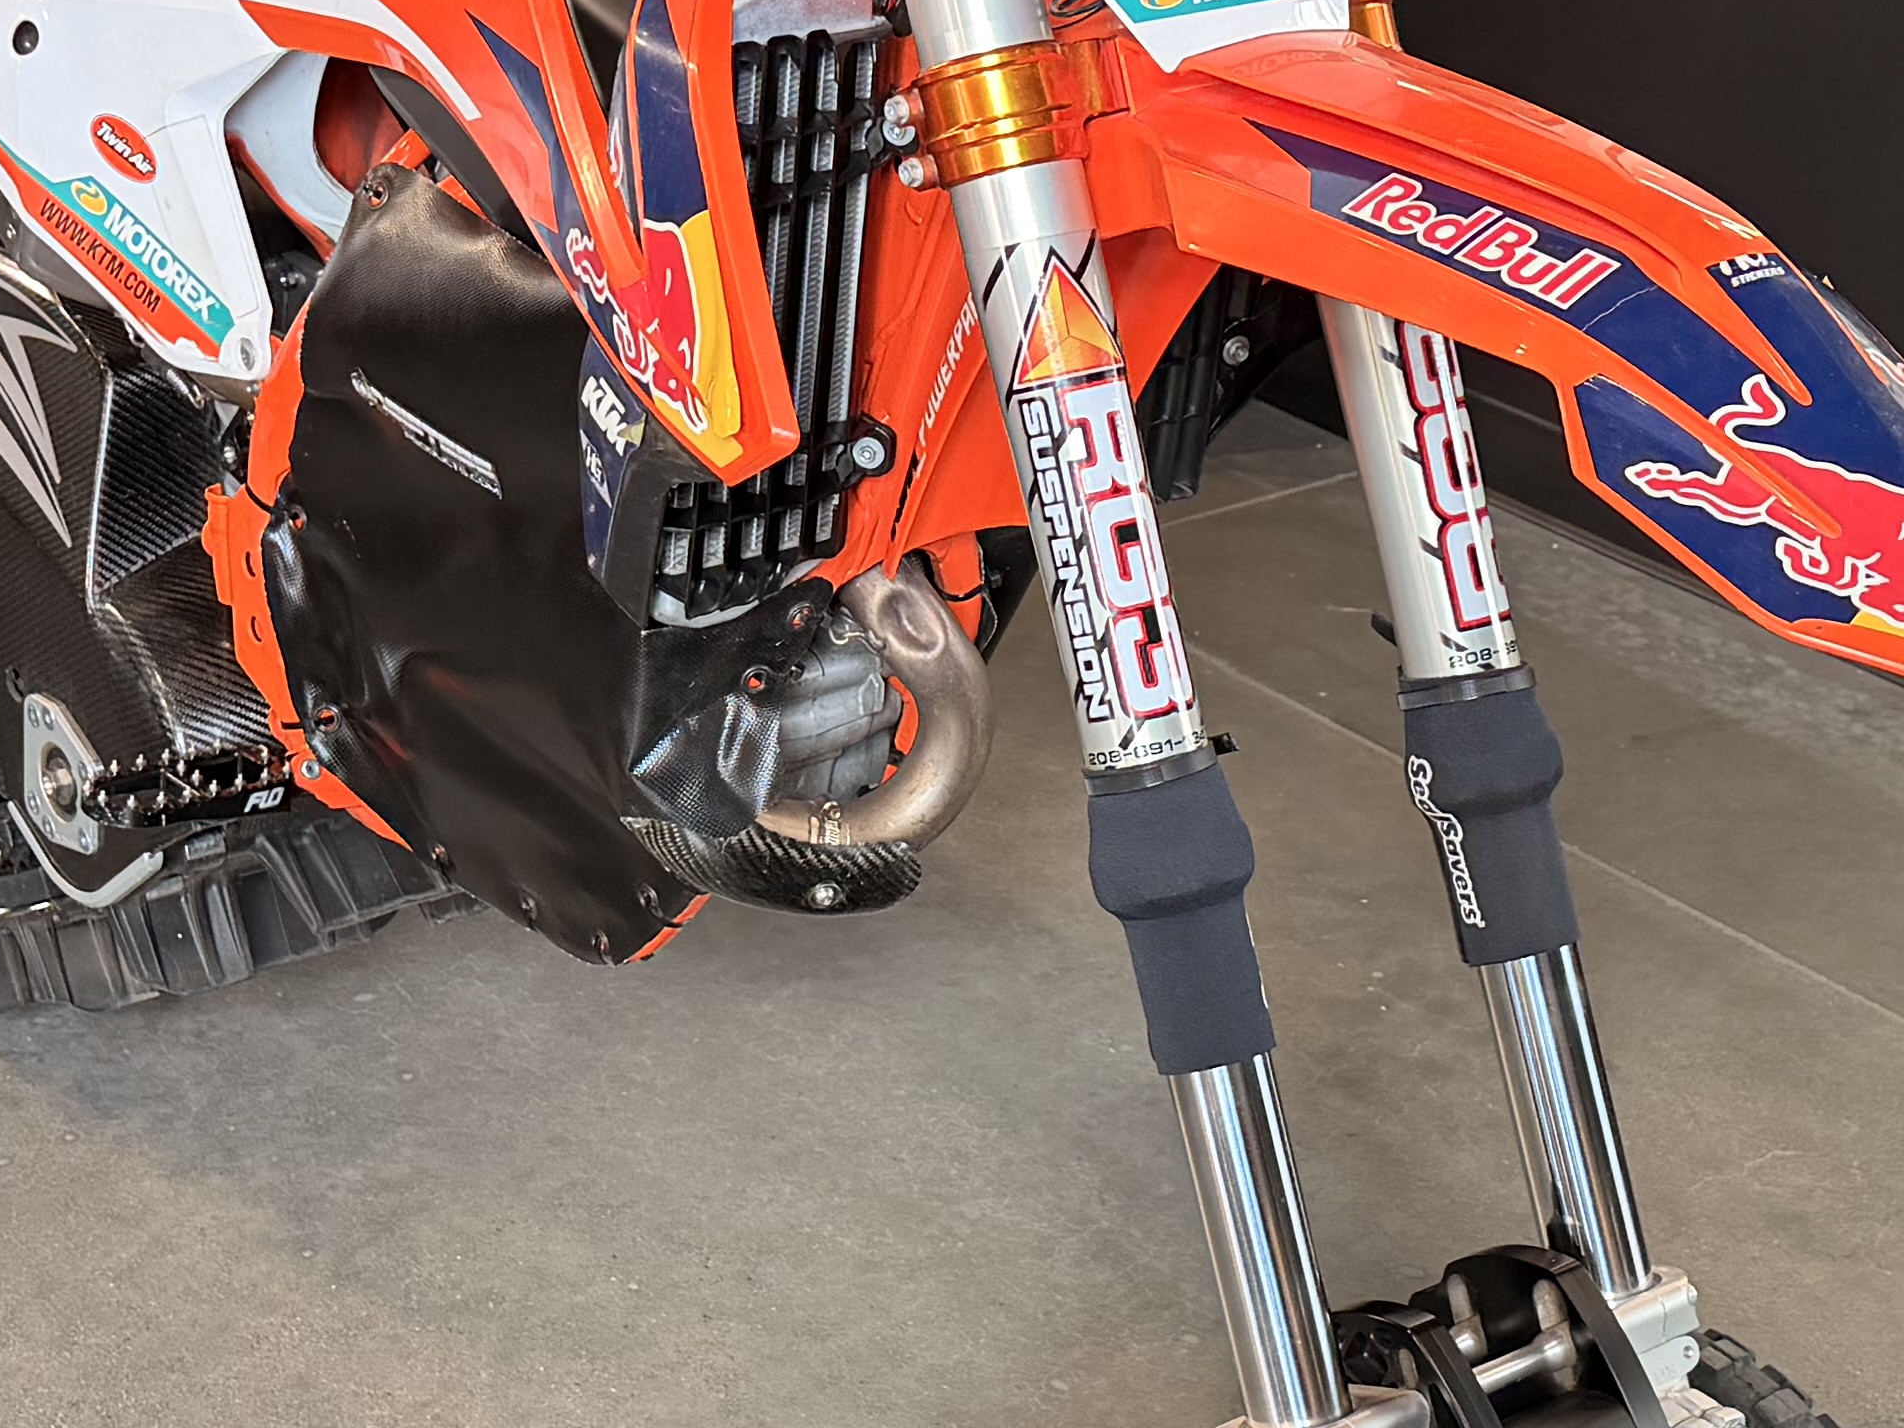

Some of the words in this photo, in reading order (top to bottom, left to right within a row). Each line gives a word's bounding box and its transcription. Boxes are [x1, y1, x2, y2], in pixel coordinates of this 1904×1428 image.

[96, 121, 132, 158] Twin
[129, 151, 157, 175] Air
[39, 197, 162, 313] WWW.KTM.COM
[102, 202, 217, 322] MOTOREX
[1341, 172, 1503, 255] Red
[1454, 216, 1622, 311] Bull
[1730, 266, 1786, 288] STICKERS
[580, 375, 627, 458] KTM
[1018, 396, 1116, 725] SUSPENSION
[243, 786, 285, 814] FLO
